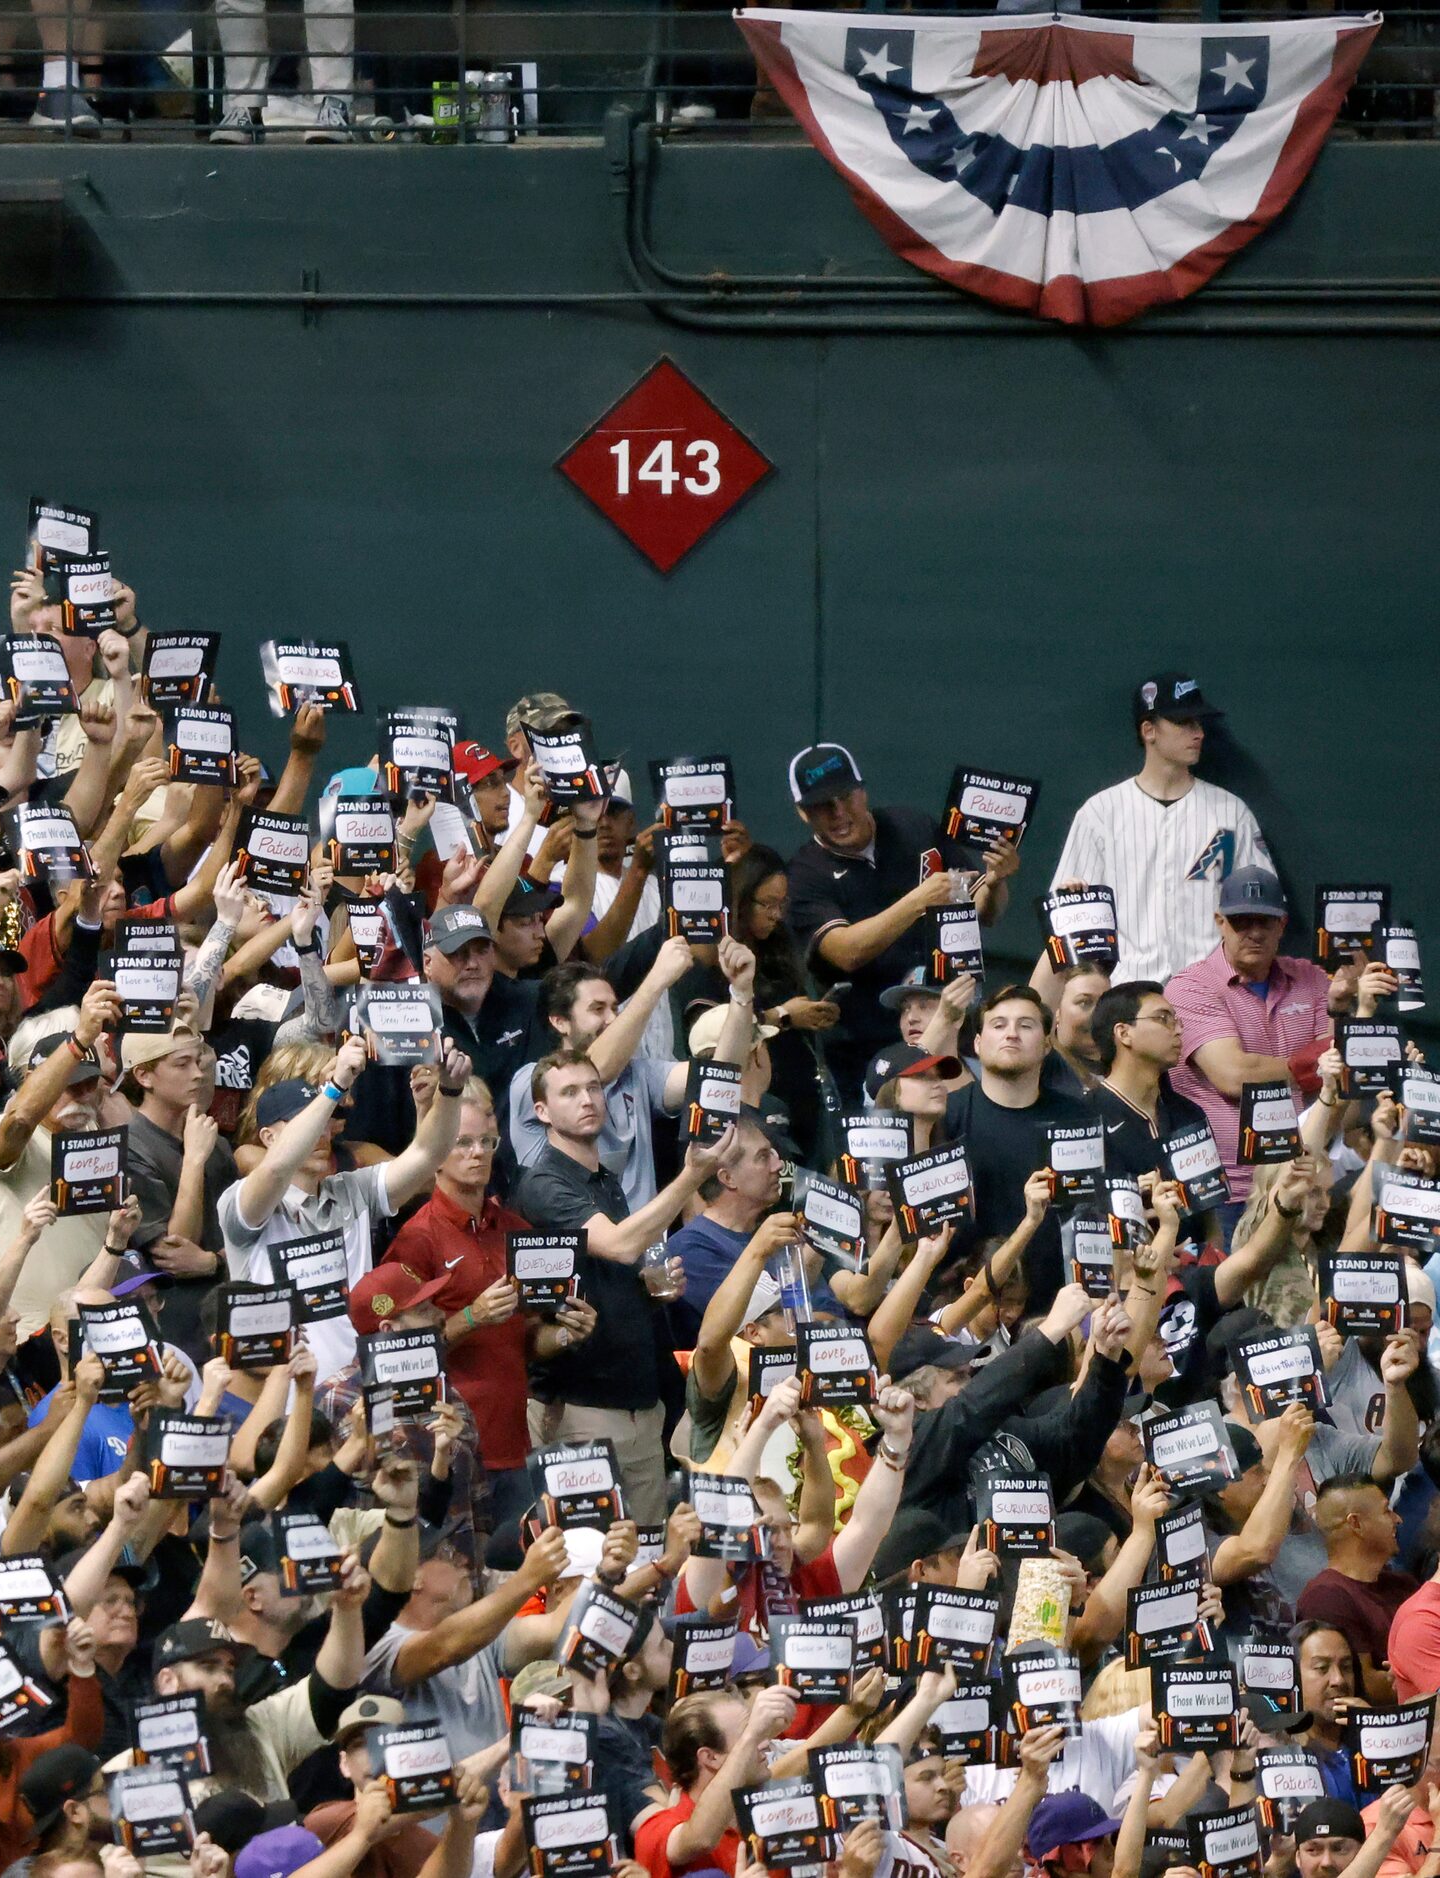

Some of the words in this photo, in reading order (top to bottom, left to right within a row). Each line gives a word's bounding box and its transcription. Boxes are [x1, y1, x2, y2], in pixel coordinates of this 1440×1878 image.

[610, 440, 720, 496] 143
[659, 768, 663, 776] I
[667, 765, 695, 776] STAND
[698, 764, 709, 773] UP
[711, 763, 725, 772] FOR
[963, 774, 968, 782] I
[970, 776, 1000, 790] STAND
[1003, 782, 1016, 792] UP
[1017, 785, 1032, 795] FOR
[971, 795, 1016, 816] Patients
[670, 869, 672, 877] I
[674, 869, 696, 878] STAND
[698, 869, 708, 877] UP
[709, 869, 724, 877] FOR
[61, 1141, 65, 1150] I
[67, 1139, 94, 1150] STAND
[96, 1136, 107, 1146] UP
[108, 1134, 121, 1144] FOR
[93, 1162, 114, 1175] ONES
[895, 1168, 900, 1177] I
[902, 1157, 933, 1176] STAND
[935, 1151, 949, 1164] UP
[950, 1145, 965, 1158] FOR
[909, 1172, 966, 1197] SURVIVORS
[513, 1238, 516, 1246] I
[517, 1237, 544, 1246] STAND
[546, 1237, 558, 1246] UP
[560, 1237, 578, 1246] FOR
[518, 1258, 545, 1272] LOVED
[545, 1258, 572, 1274] ONES
[1329, 1260, 1333, 1269] I
[1336, 1260, 1368, 1269] STAND
[1370, 1261, 1382, 1269] UP
[1384, 1261, 1399, 1270] FOR
[805, 1331, 808, 1340] I
[810, 1329, 838, 1340] STAND
[839, 1328, 849, 1338] UP
[850, 1328, 863, 1337] FOR
[368, 1342, 372, 1352] I
[374, 1339, 406, 1351] STAND
[408, 1336, 420, 1346] UP
[421, 1334, 435, 1344] FOR
[1240, 1348, 1244, 1356] I
[1246, 1340, 1278, 1355] STAND
[1280, 1336, 1293, 1346] UP
[1294, 1332, 1310, 1344] FOR
[841, 1355, 864, 1365] ONES
[1149, 1427, 1152, 1435] I
[1153, 1419, 1178, 1434] STAND
[1180, 1415, 1192, 1425] UP
[1194, 1410, 1211, 1421] FOR
[1156, 1445, 1176, 1458] Those
[1198, 1432, 1211, 1445] Lost
[988, 1480, 991, 1489] I
[994, 1480, 1024, 1490] STAND
[1026, 1480, 1036, 1489] UP
[995, 1503, 1048, 1515] SURVIVORS
[1162, 1672, 1166, 1682] I
[1169, 1672, 1203, 1682] STAND
[1206, 1671, 1218, 1680] UP
[1219, 1670, 1232, 1679] FOR
[1172, 1695, 1192, 1708] Those
[1216, 1695, 1229, 1706] Lost
[1356, 1714, 1360, 1724] I
[1362, 1715, 1397, 1725] STAND
[1400, 1712, 1413, 1722] UP
[1415, 1706, 1429, 1718] FOR
